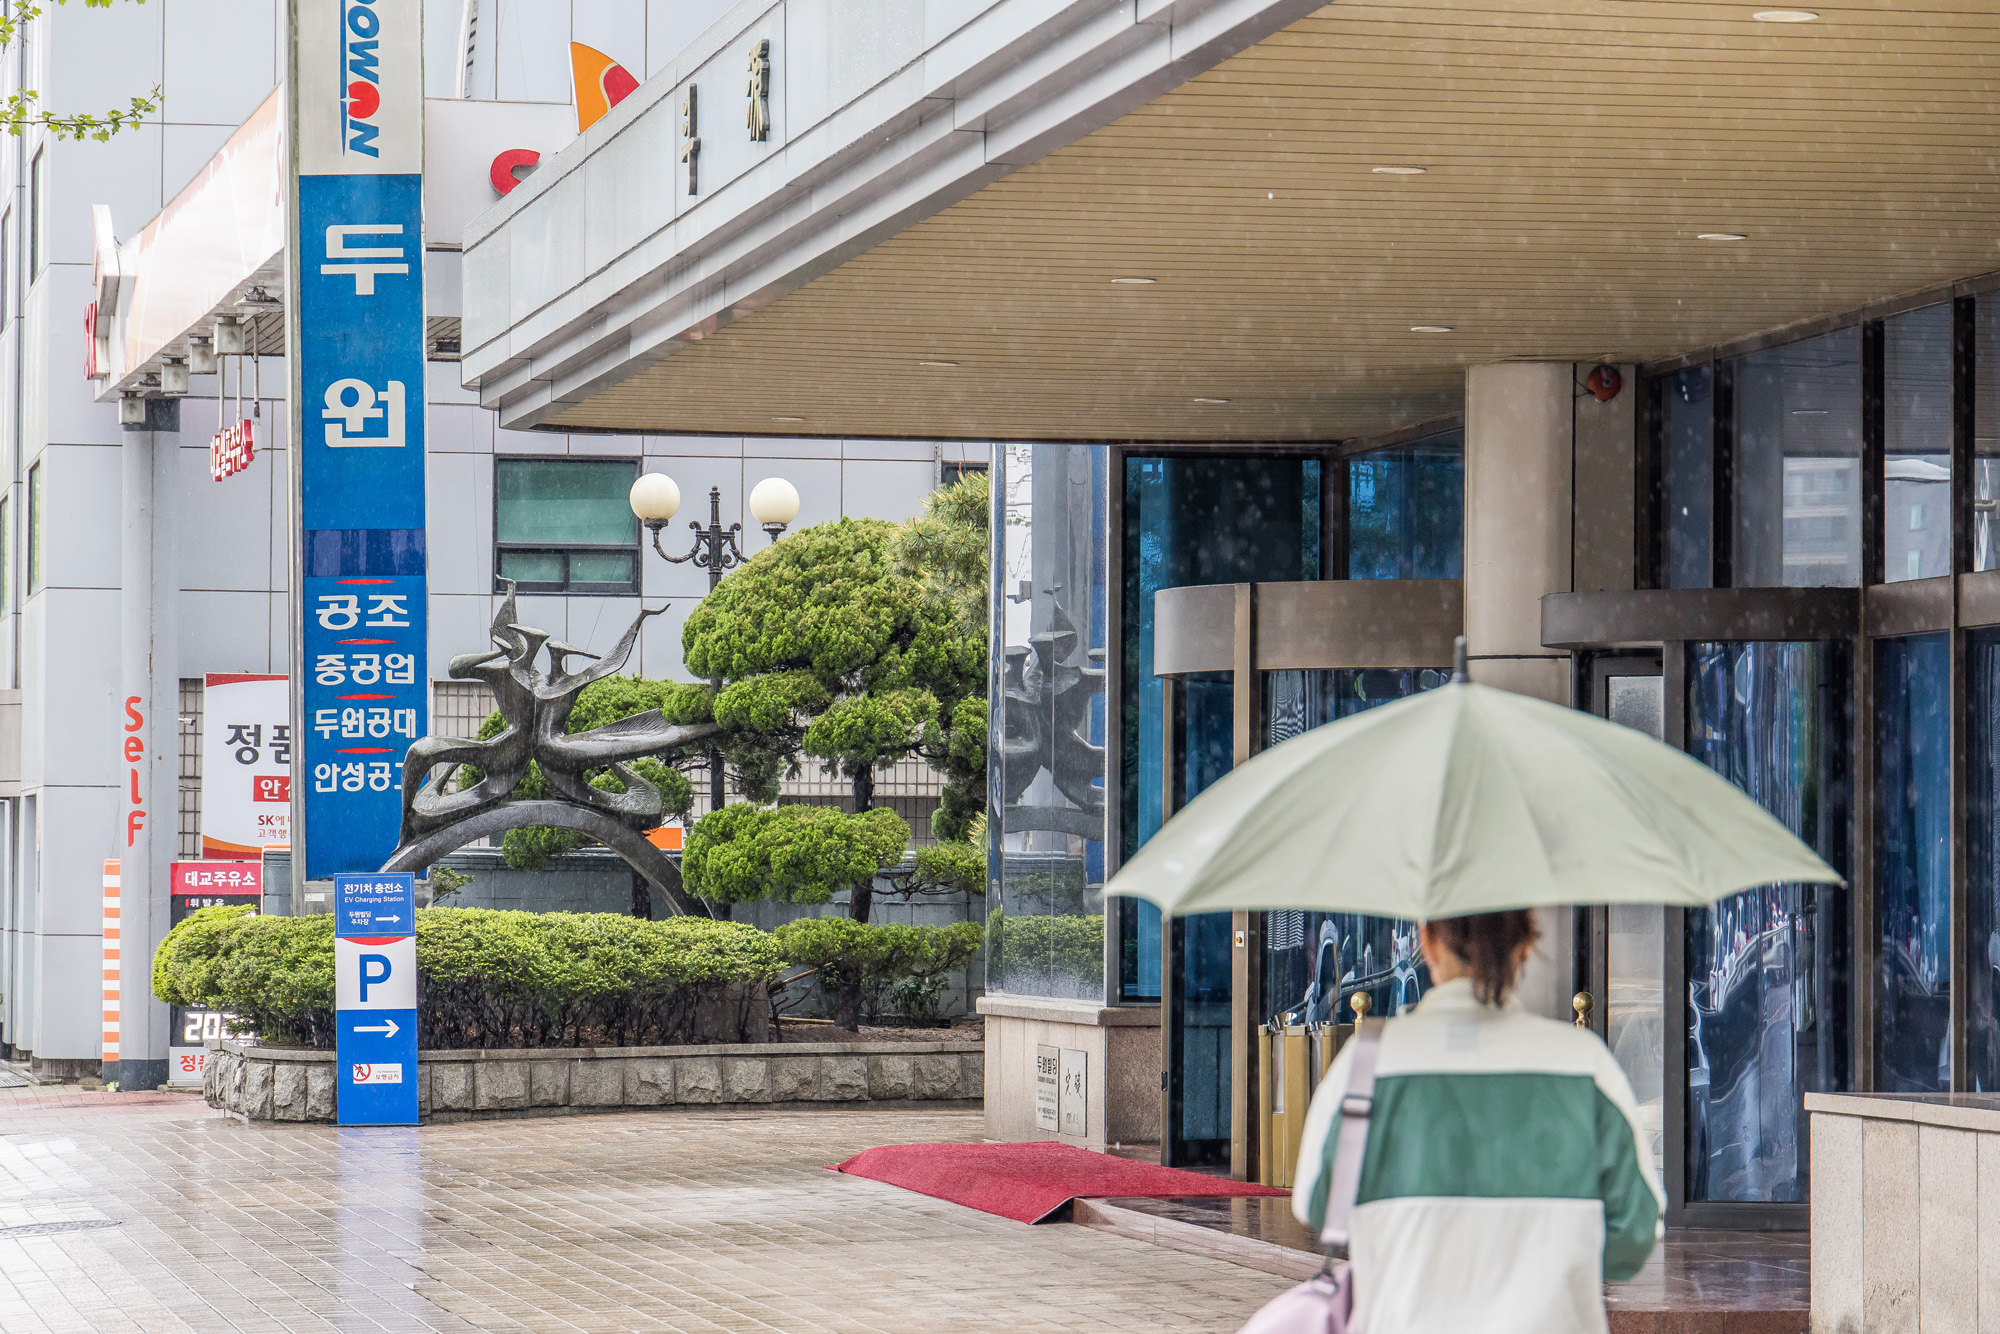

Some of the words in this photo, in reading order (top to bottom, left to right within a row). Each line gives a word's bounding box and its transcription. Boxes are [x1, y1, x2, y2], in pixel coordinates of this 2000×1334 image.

[348, 0, 380, 158] OWON
[320, 224, 409, 447] 두원
[315, 594, 410, 630] 공조
[315, 653, 415, 686] 중공업
[314, 708, 417, 739] 두원공대
[184, 870, 256, 887] 대교주유소
[344, 884, 373, 894] 전기차
[374, 882, 404, 894] 충전소
[354, 896, 382, 904] Charging
[383, 895, 405, 903] Station
[350, 918, 370, 926] 주차장
[359, 953, 392, 1003] P
[375, 1073, 400, 1081] 보행금지
